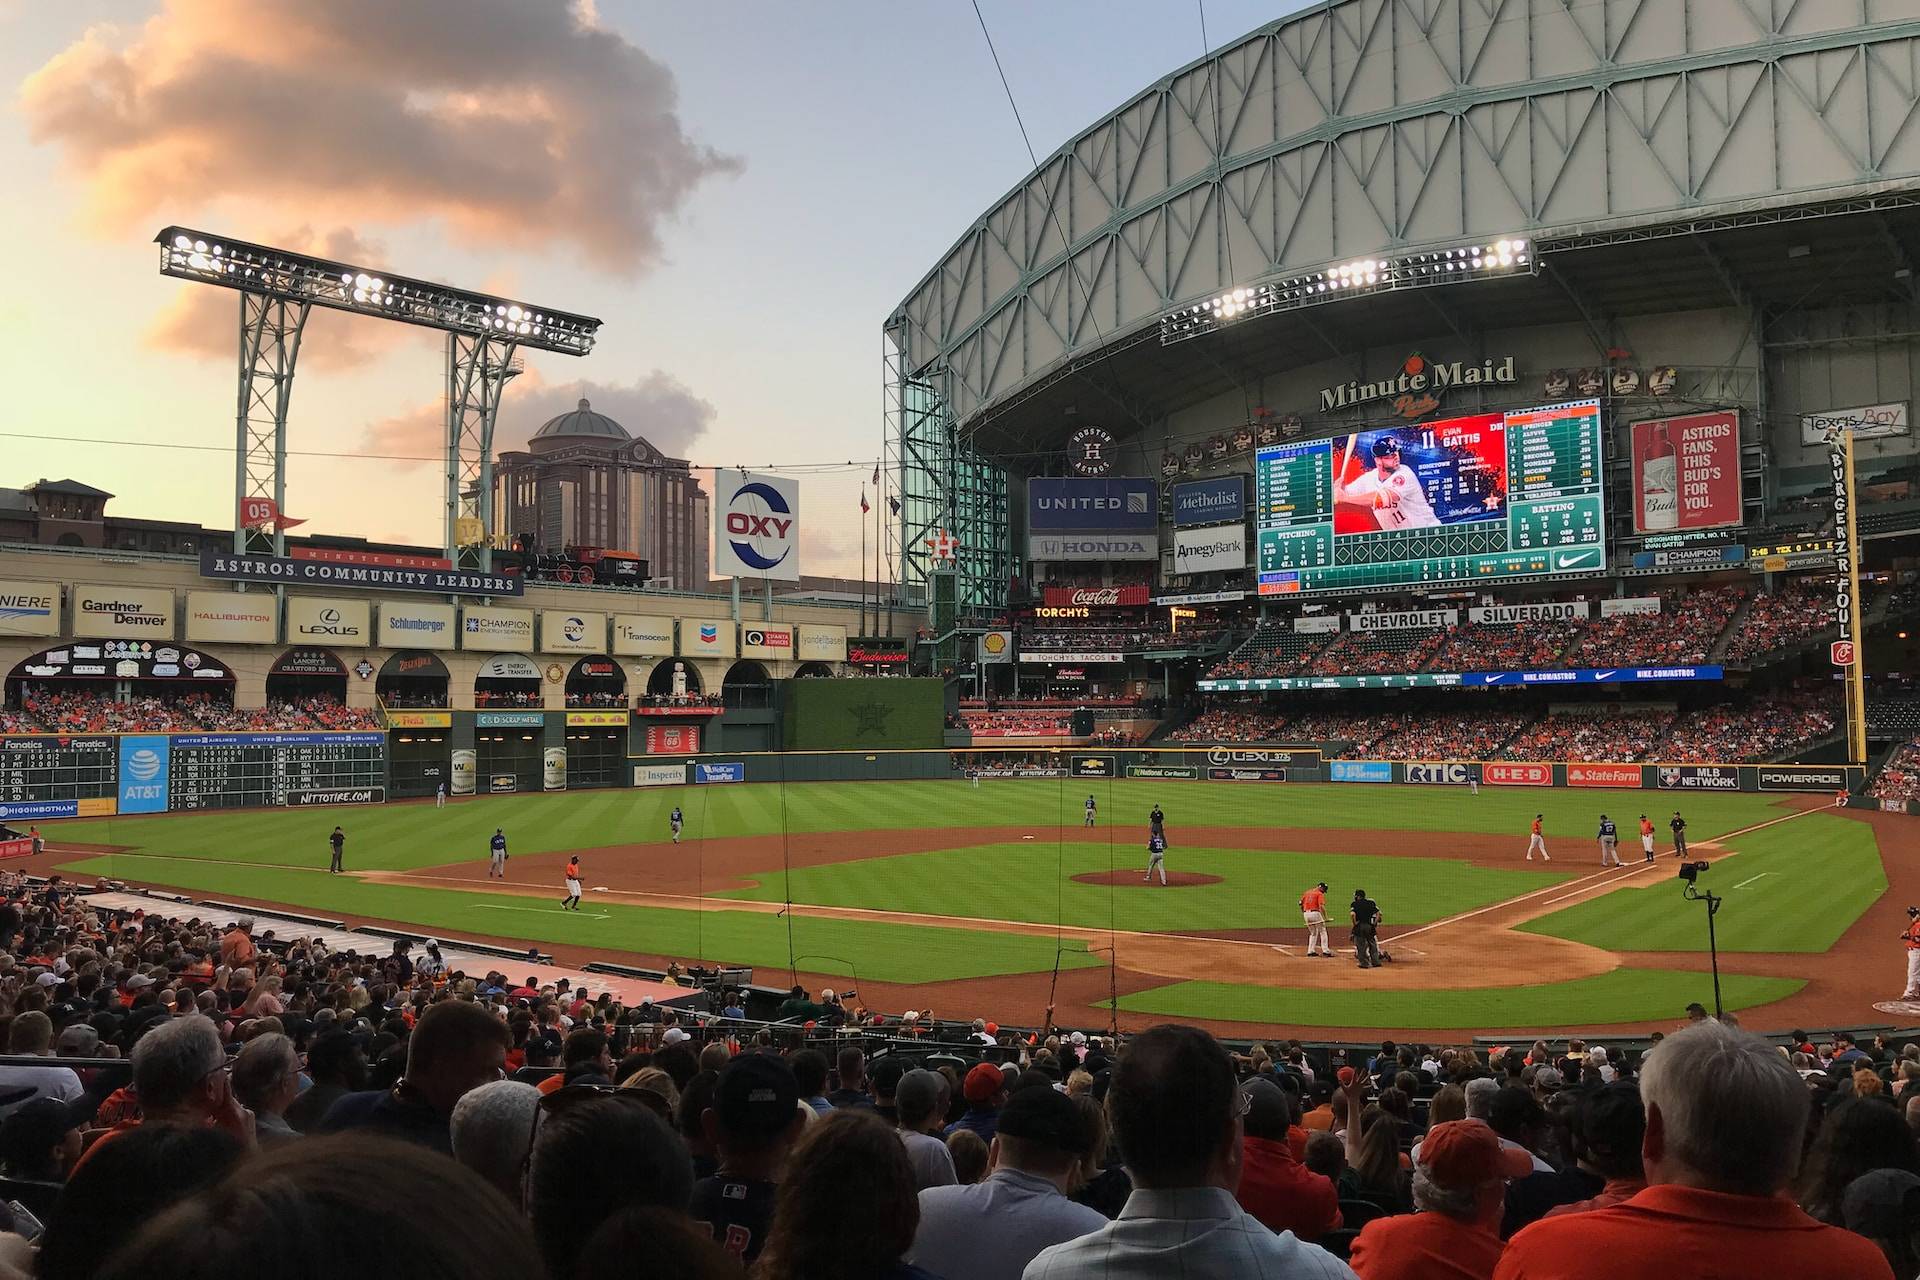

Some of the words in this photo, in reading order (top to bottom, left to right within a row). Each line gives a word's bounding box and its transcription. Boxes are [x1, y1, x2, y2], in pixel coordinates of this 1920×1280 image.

[1319, 373, 1428, 412] Minute
[1433, 356, 1517, 388] Maid
[1860, 408, 1901, 427] Bay
[1442, 427, 1462, 436] EVAN
[1489, 423, 1504, 431] DH
[1682, 424, 1730, 441] ASTROS
[1073, 428, 1112, 443] HOUSTON
[1421, 431, 1436, 449] 11
[1443, 433, 1481, 448] GATTIS
[1084, 443, 1101, 460] H
[1279, 448, 1309, 458] TEXAS
[1683, 440, 1717, 454] FANS,
[1075, 461, 1110, 474] ASTROS
[1683, 454, 1711, 468] THIS
[1684, 467, 1721, 482] BUD'S
[1684, 482, 1708, 496] FOR
[1038, 498, 1122, 510] UNITED
[1179, 491, 1238, 510] Methodist
[1684, 497, 1713, 510] YOU.
[249, 503, 271, 519] 05
[1532, 503, 1575, 514] BATTING
[1392, 510, 1406, 524] 11
[726, 512, 793, 540] OXY
[1278, 529, 1316, 540] PITCHING
[1645, 534, 1682, 543] DESIGNATED
[1062, 542, 1147, 553] HONDA
[1177, 540, 1241, 559] AmegyBank
[1776, 545, 1792, 554] TEX
[309, 551, 379, 563] MINUTE
[395, 559, 438, 567] MAID
[1668, 549, 1721, 560] CHAMPION
[1785, 557, 1824, 568] generation
[213, 559, 295, 576] ASTROS
[304, 565, 428, 585] COMMUNITY
[436, 575, 514, 591] LEADERS
[1071, 588, 1122, 605] Coca-Cola
[82, 599, 143, 613] Gardner
[1836, 578, 1850, 638] FOUL
[114, 613, 167, 626] Denver
[193, 612, 270, 623] HALLIBURTON
[1483, 605, 1575, 622] SILVERADO
[390, 617, 445, 632] Schlumberger
[480, 618, 530, 629] CHAMPION
[1359, 612, 1447, 629] CHEVROLET
[300, 625, 359, 636] LEXUS
[628, 632, 671, 641] Transocean
[849, 648, 908, 664] Budweiser
[1523, 672, 1576, 681] NIKE.COM/ASTROS
[1637, 669, 1695, 678] NIKE.COM/ASTROS
[501, 716, 521, 724] SCRAP
[522, 716, 539, 724] METAL
[1003, 729, 1041, 737] Budweiser
[5, 740, 42, 749] Fanatics
[71, 740, 107, 748] Fanatics
[667, 737, 678, 746] 66
[648, 770, 684, 781] Insperity
[1407, 763, 1467, 782] RTIC
[1493, 768, 1542, 780] H-E-B
[1697, 768, 1720, 777] MLB
[1762, 774, 1841, 784] POWERADE
[1682, 776, 1736, 787] NETWORK
[125, 785, 162, 800] AT&T
[300, 791, 371, 804] NITTOTIRE.COM
